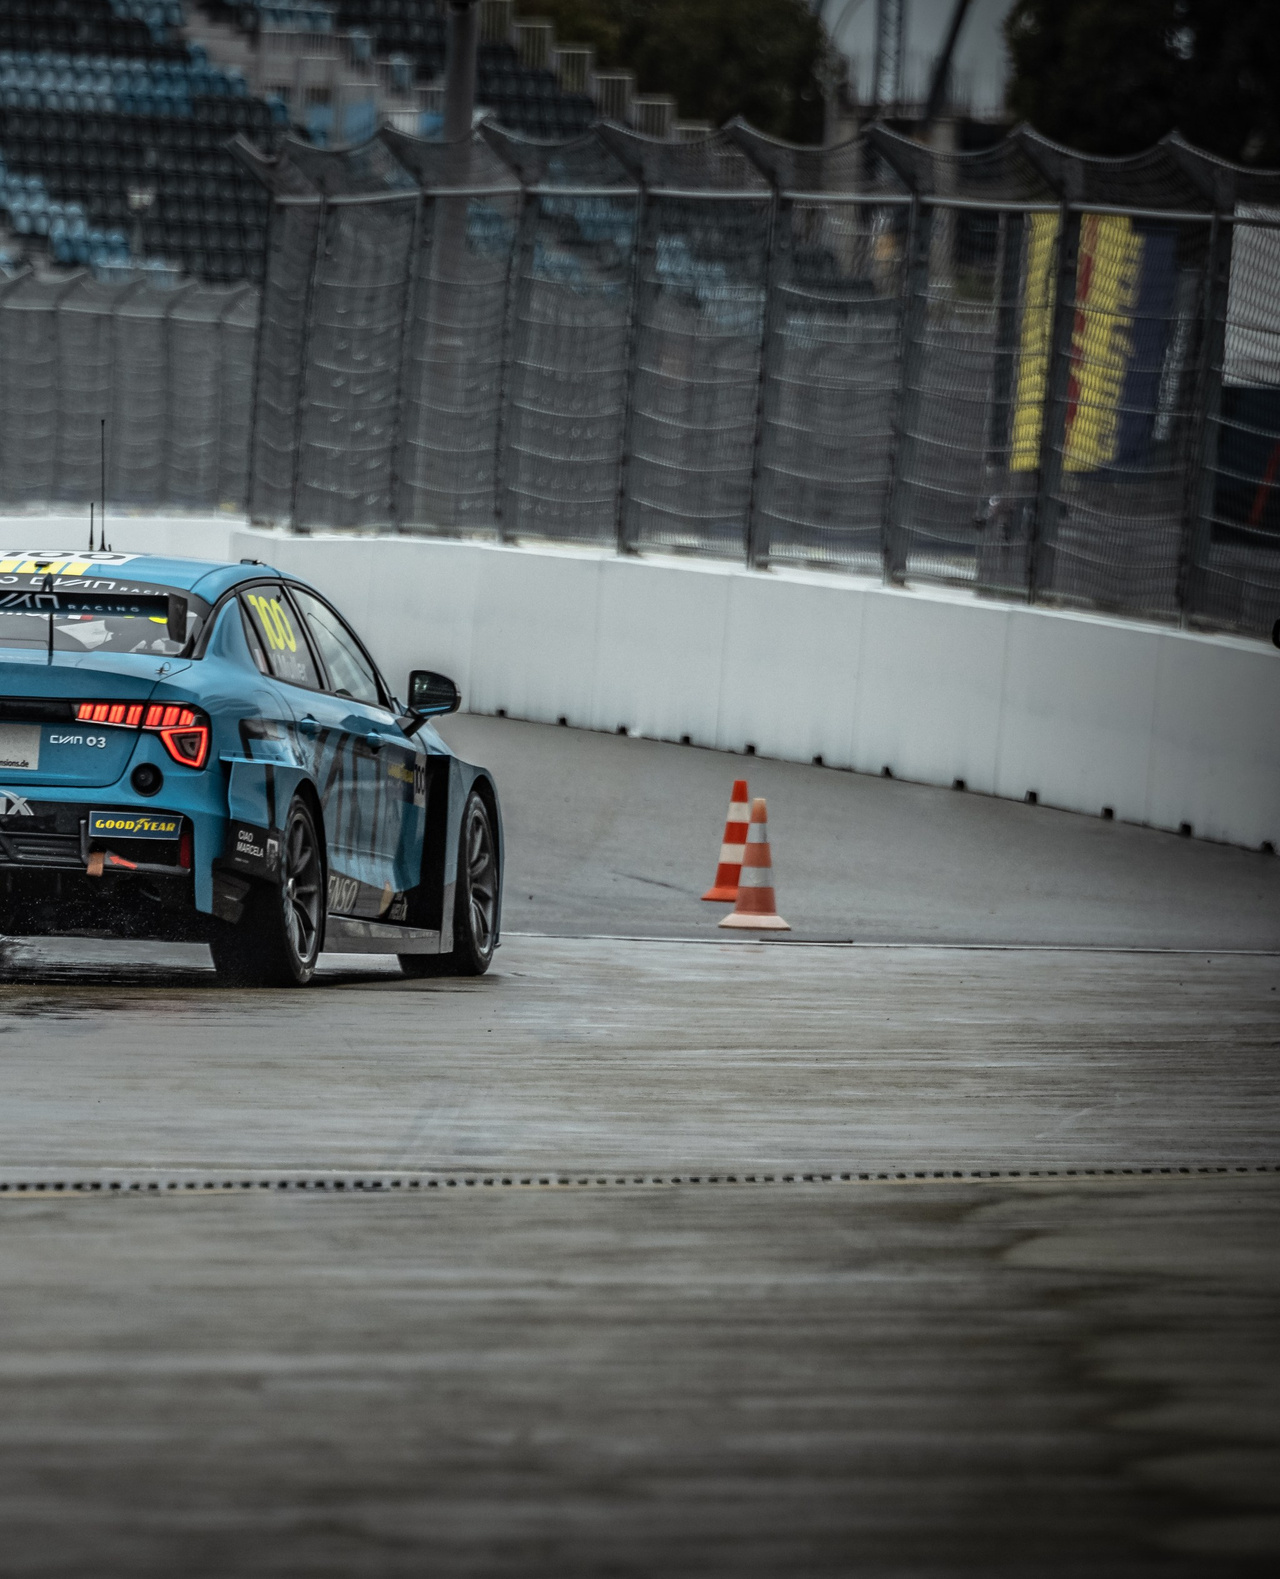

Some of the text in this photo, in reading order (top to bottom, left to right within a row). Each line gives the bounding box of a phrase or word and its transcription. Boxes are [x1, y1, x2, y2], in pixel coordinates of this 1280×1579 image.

[120, 587, 169, 596] RACIN
[67, 604, 140, 613] RACING
[247, 594, 297, 653] 100
[86, 736, 107, 749] 03
[95, 818, 176, 833] GOODYEAR
[238, 830, 254, 843] CIAO
[236, 841, 264, 858] MARCELA
[328, 875, 358, 912] ENSO
